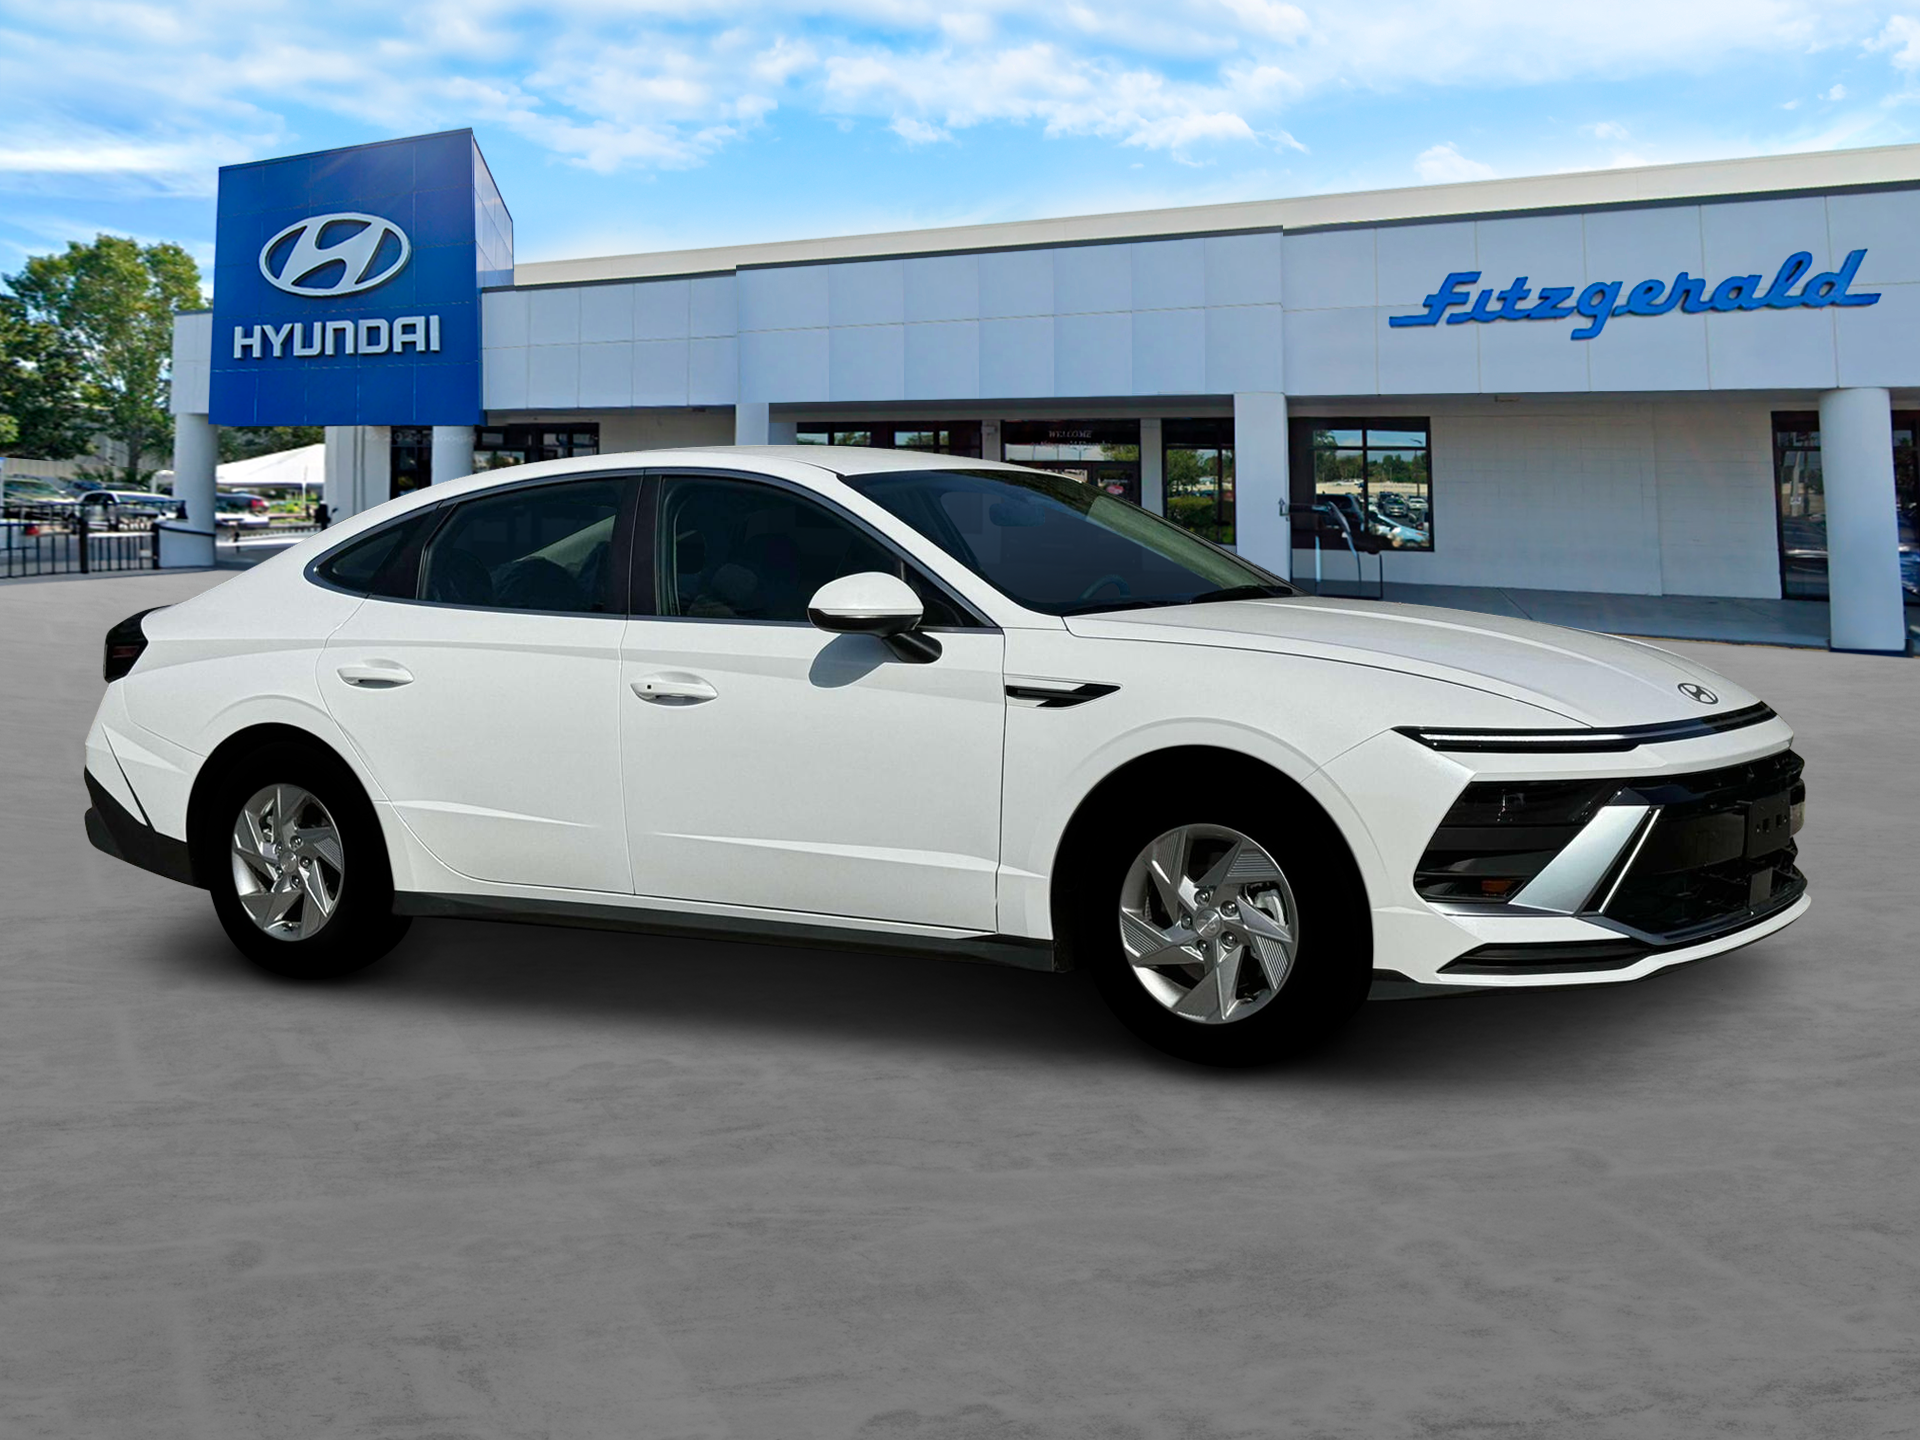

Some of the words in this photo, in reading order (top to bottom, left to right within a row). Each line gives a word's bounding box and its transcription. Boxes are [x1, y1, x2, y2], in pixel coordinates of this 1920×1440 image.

[1389, 249, 1881, 340] Fitzgerald
[233, 315, 440, 359] HYUNDAI
[1048, 430, 1092, 438] WELCOME
